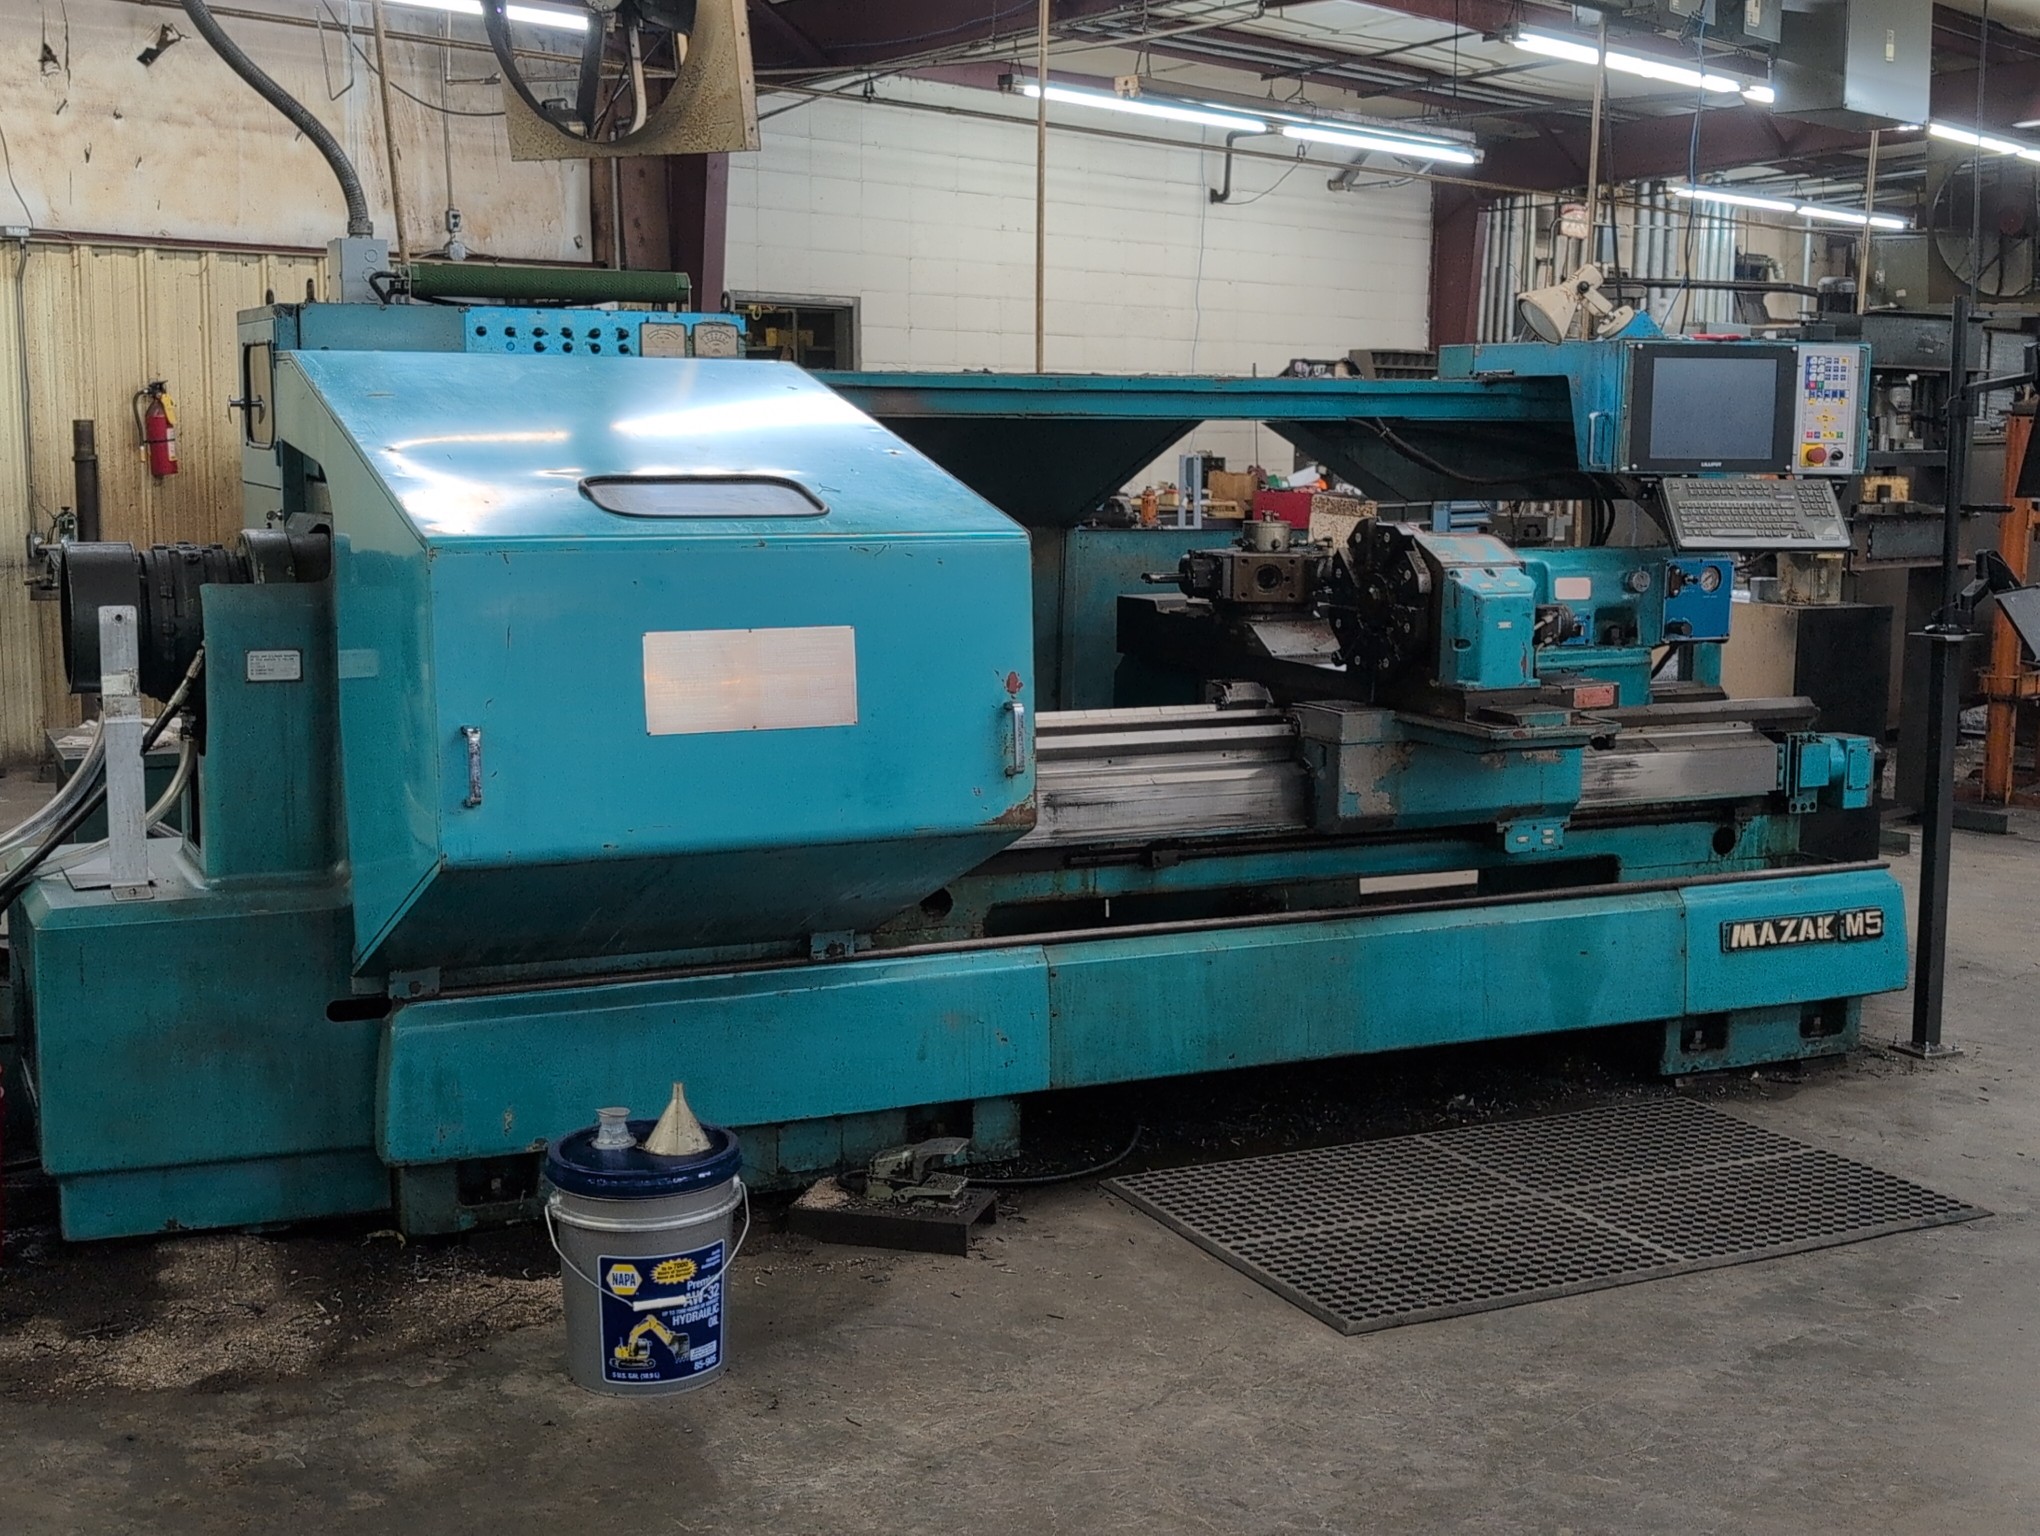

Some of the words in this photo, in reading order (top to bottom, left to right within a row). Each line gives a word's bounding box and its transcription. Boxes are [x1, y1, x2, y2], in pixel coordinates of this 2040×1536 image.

[1731, 914, 1836, 948] MAZAK
[1845, 910, 1882, 937] M5
[612, 1272, 636, 1287] NAPA
[672, 1302, 720, 1326] HYDRAULIC
